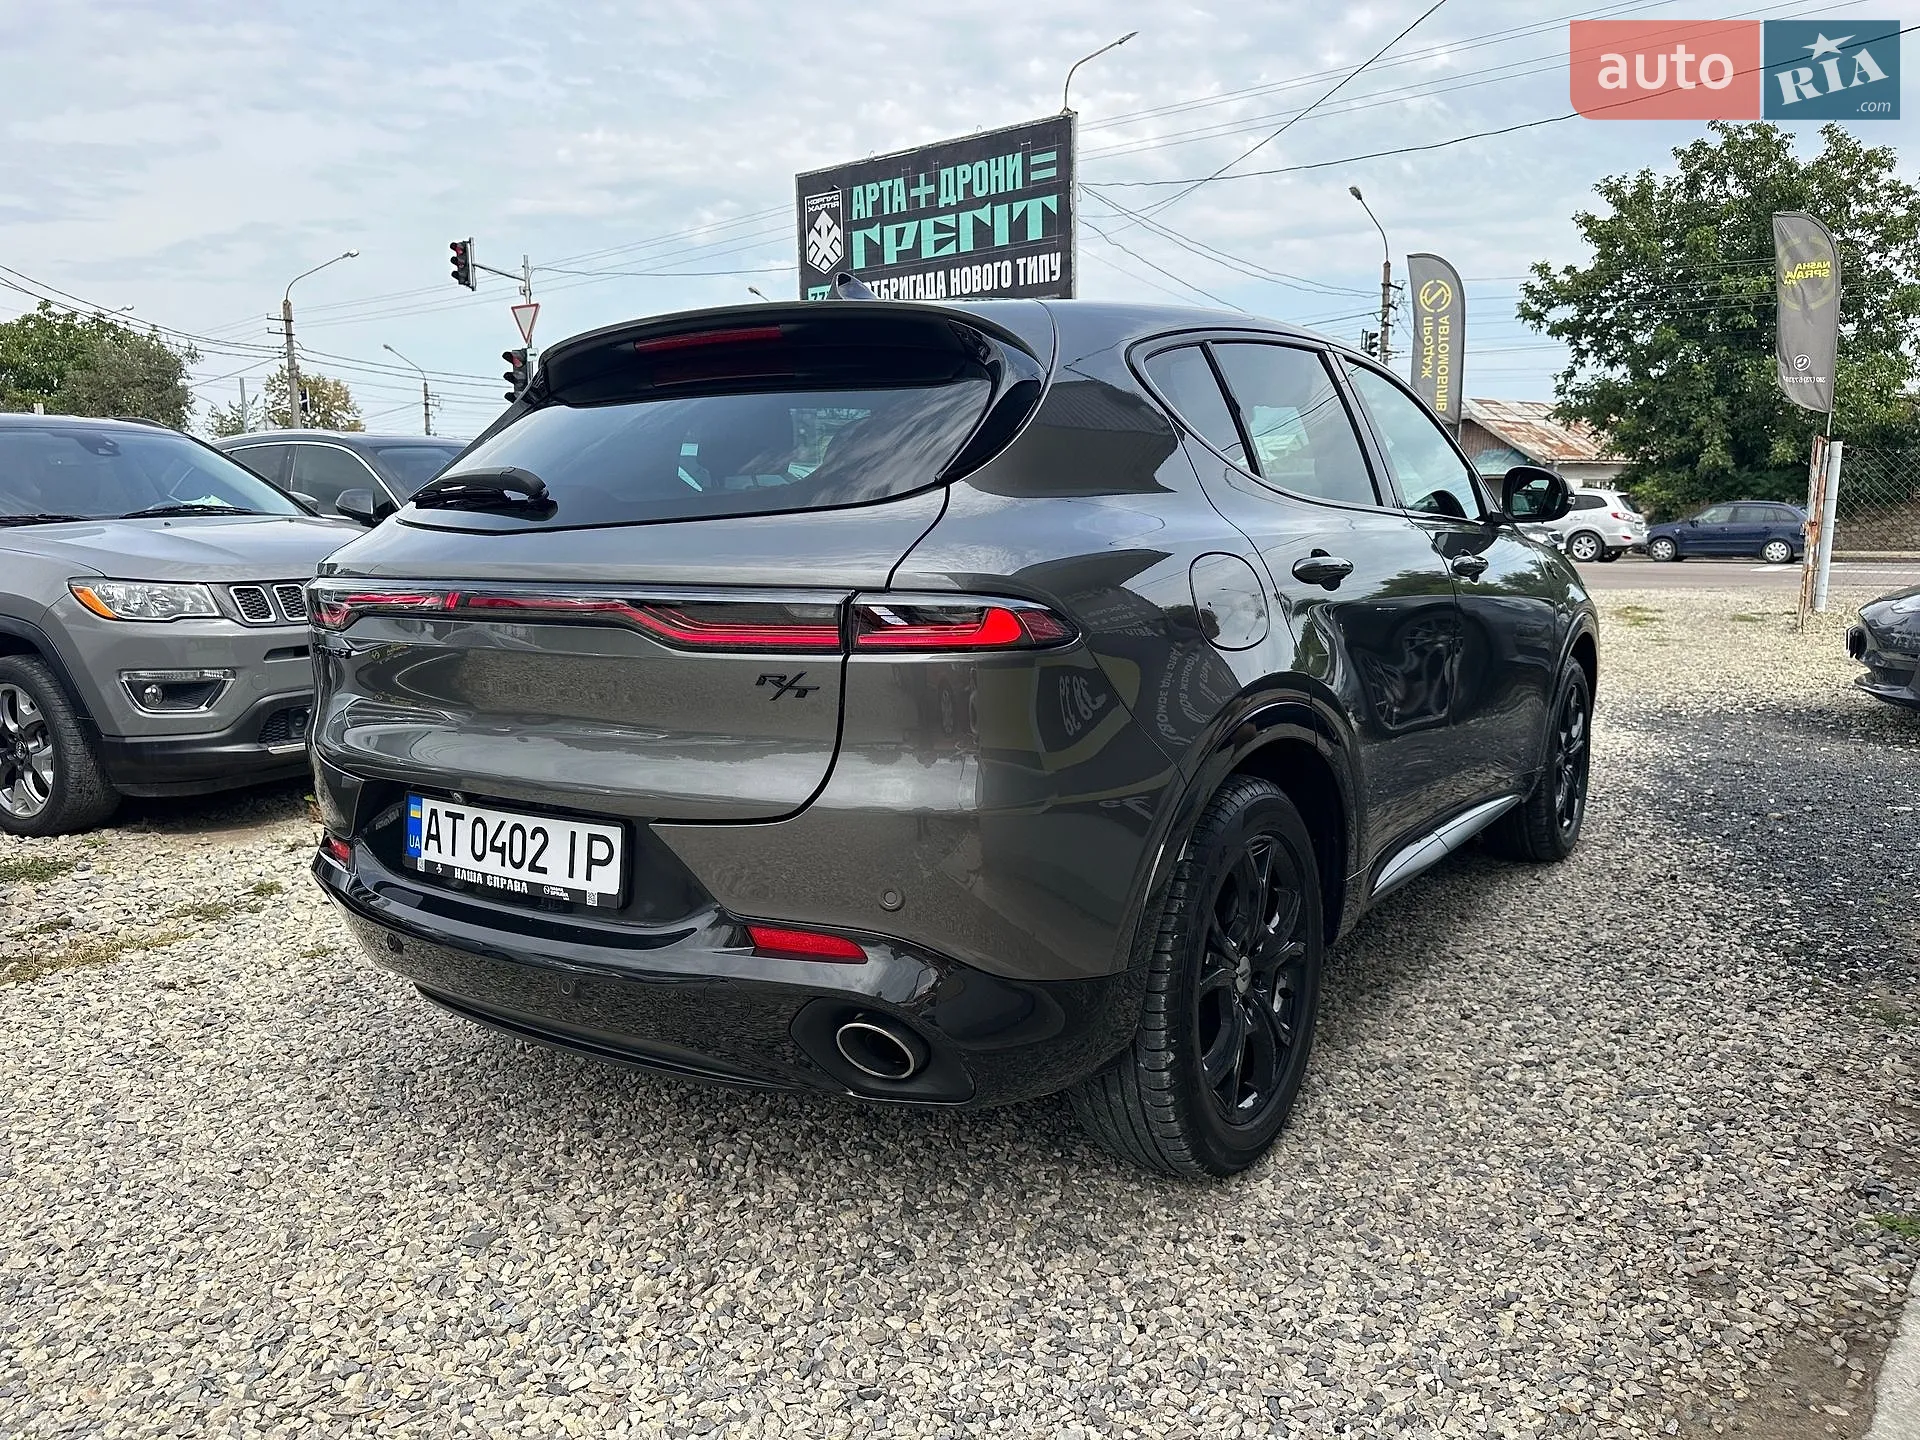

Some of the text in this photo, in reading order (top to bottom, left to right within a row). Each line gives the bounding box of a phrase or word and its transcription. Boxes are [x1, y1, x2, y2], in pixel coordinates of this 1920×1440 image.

[808, 194, 839, 206] КОРПУС
[852, 177, 907, 220] АРТА
[938, 152, 1023, 208] ДРОНИ
[950, 260, 1009, 297] НОВОГО
[1016, 251, 1062, 288] ТИПУ
[755, 671, 820, 701] R/T
[409, 837, 421, 850] UA
[424, 808, 465, 857] AT
[470, 816, 550, 874] 0402
[568, 830, 615, 882] IP
[454, 867, 528, 894] НАША СПРАВА
